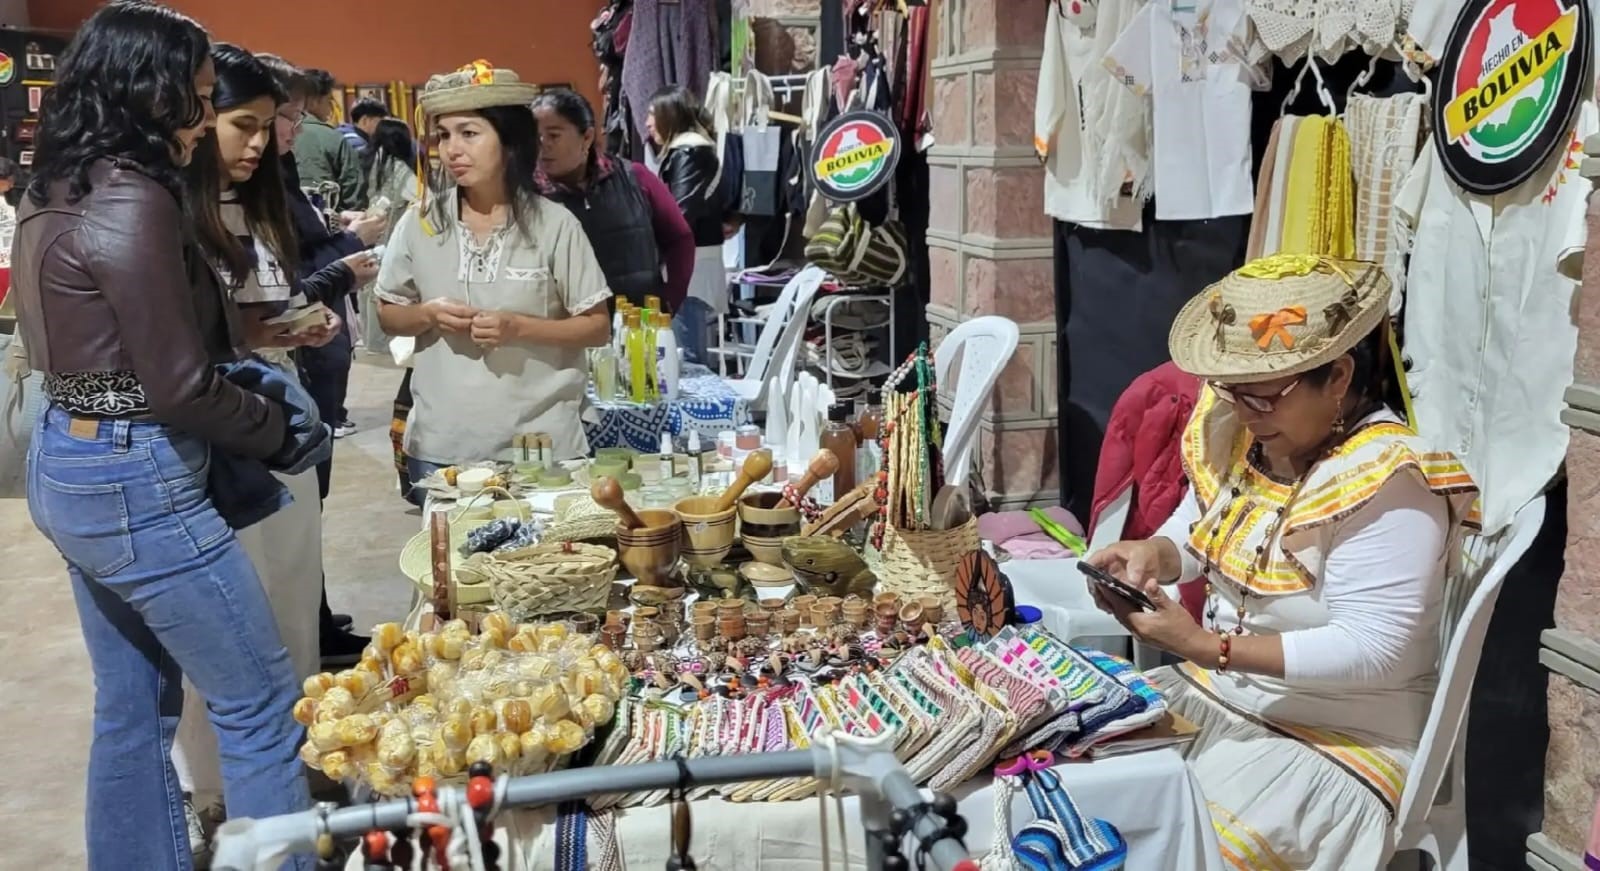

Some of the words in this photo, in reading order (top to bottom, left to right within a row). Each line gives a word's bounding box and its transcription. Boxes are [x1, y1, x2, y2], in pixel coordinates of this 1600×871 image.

[1481, 44, 1510, 76] HECHO
[1511, 33, 1524, 51] EN
[1463, 31, 1562, 122] BOLIVIA
[826, 144, 883, 172] BOLIVIA
